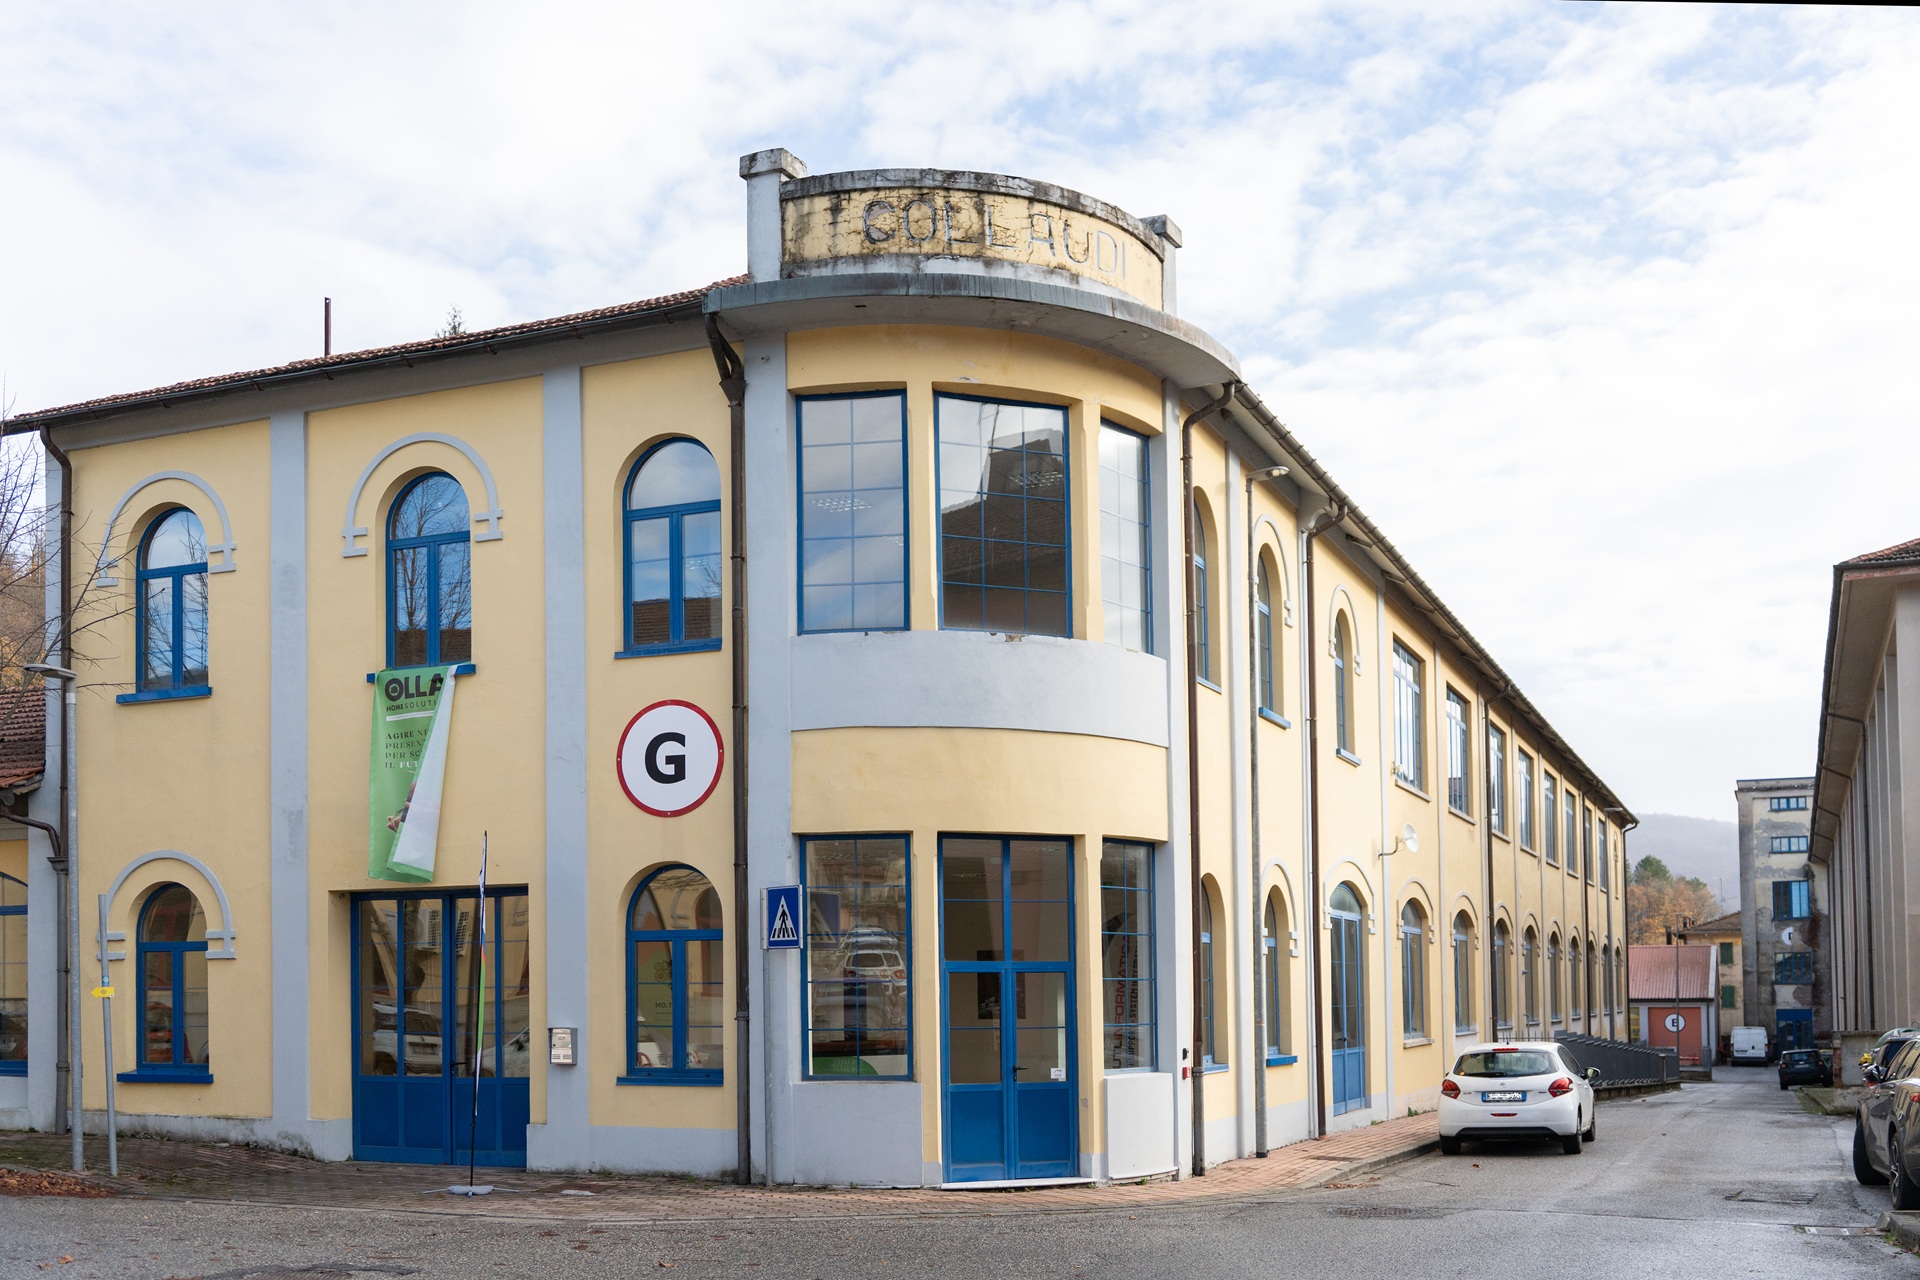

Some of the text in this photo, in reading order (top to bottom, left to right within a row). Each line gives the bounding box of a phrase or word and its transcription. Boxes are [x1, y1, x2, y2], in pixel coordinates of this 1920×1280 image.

[862, 200, 1126, 281] COLLAUDI
[385, 673, 444, 702] OLLA
[386, 731, 415, 740] AGIRE
[385, 761, 395, 769] IL
[644, 731, 686, 784] G
[1129, 988, 1138, 1018] SYSTEM
